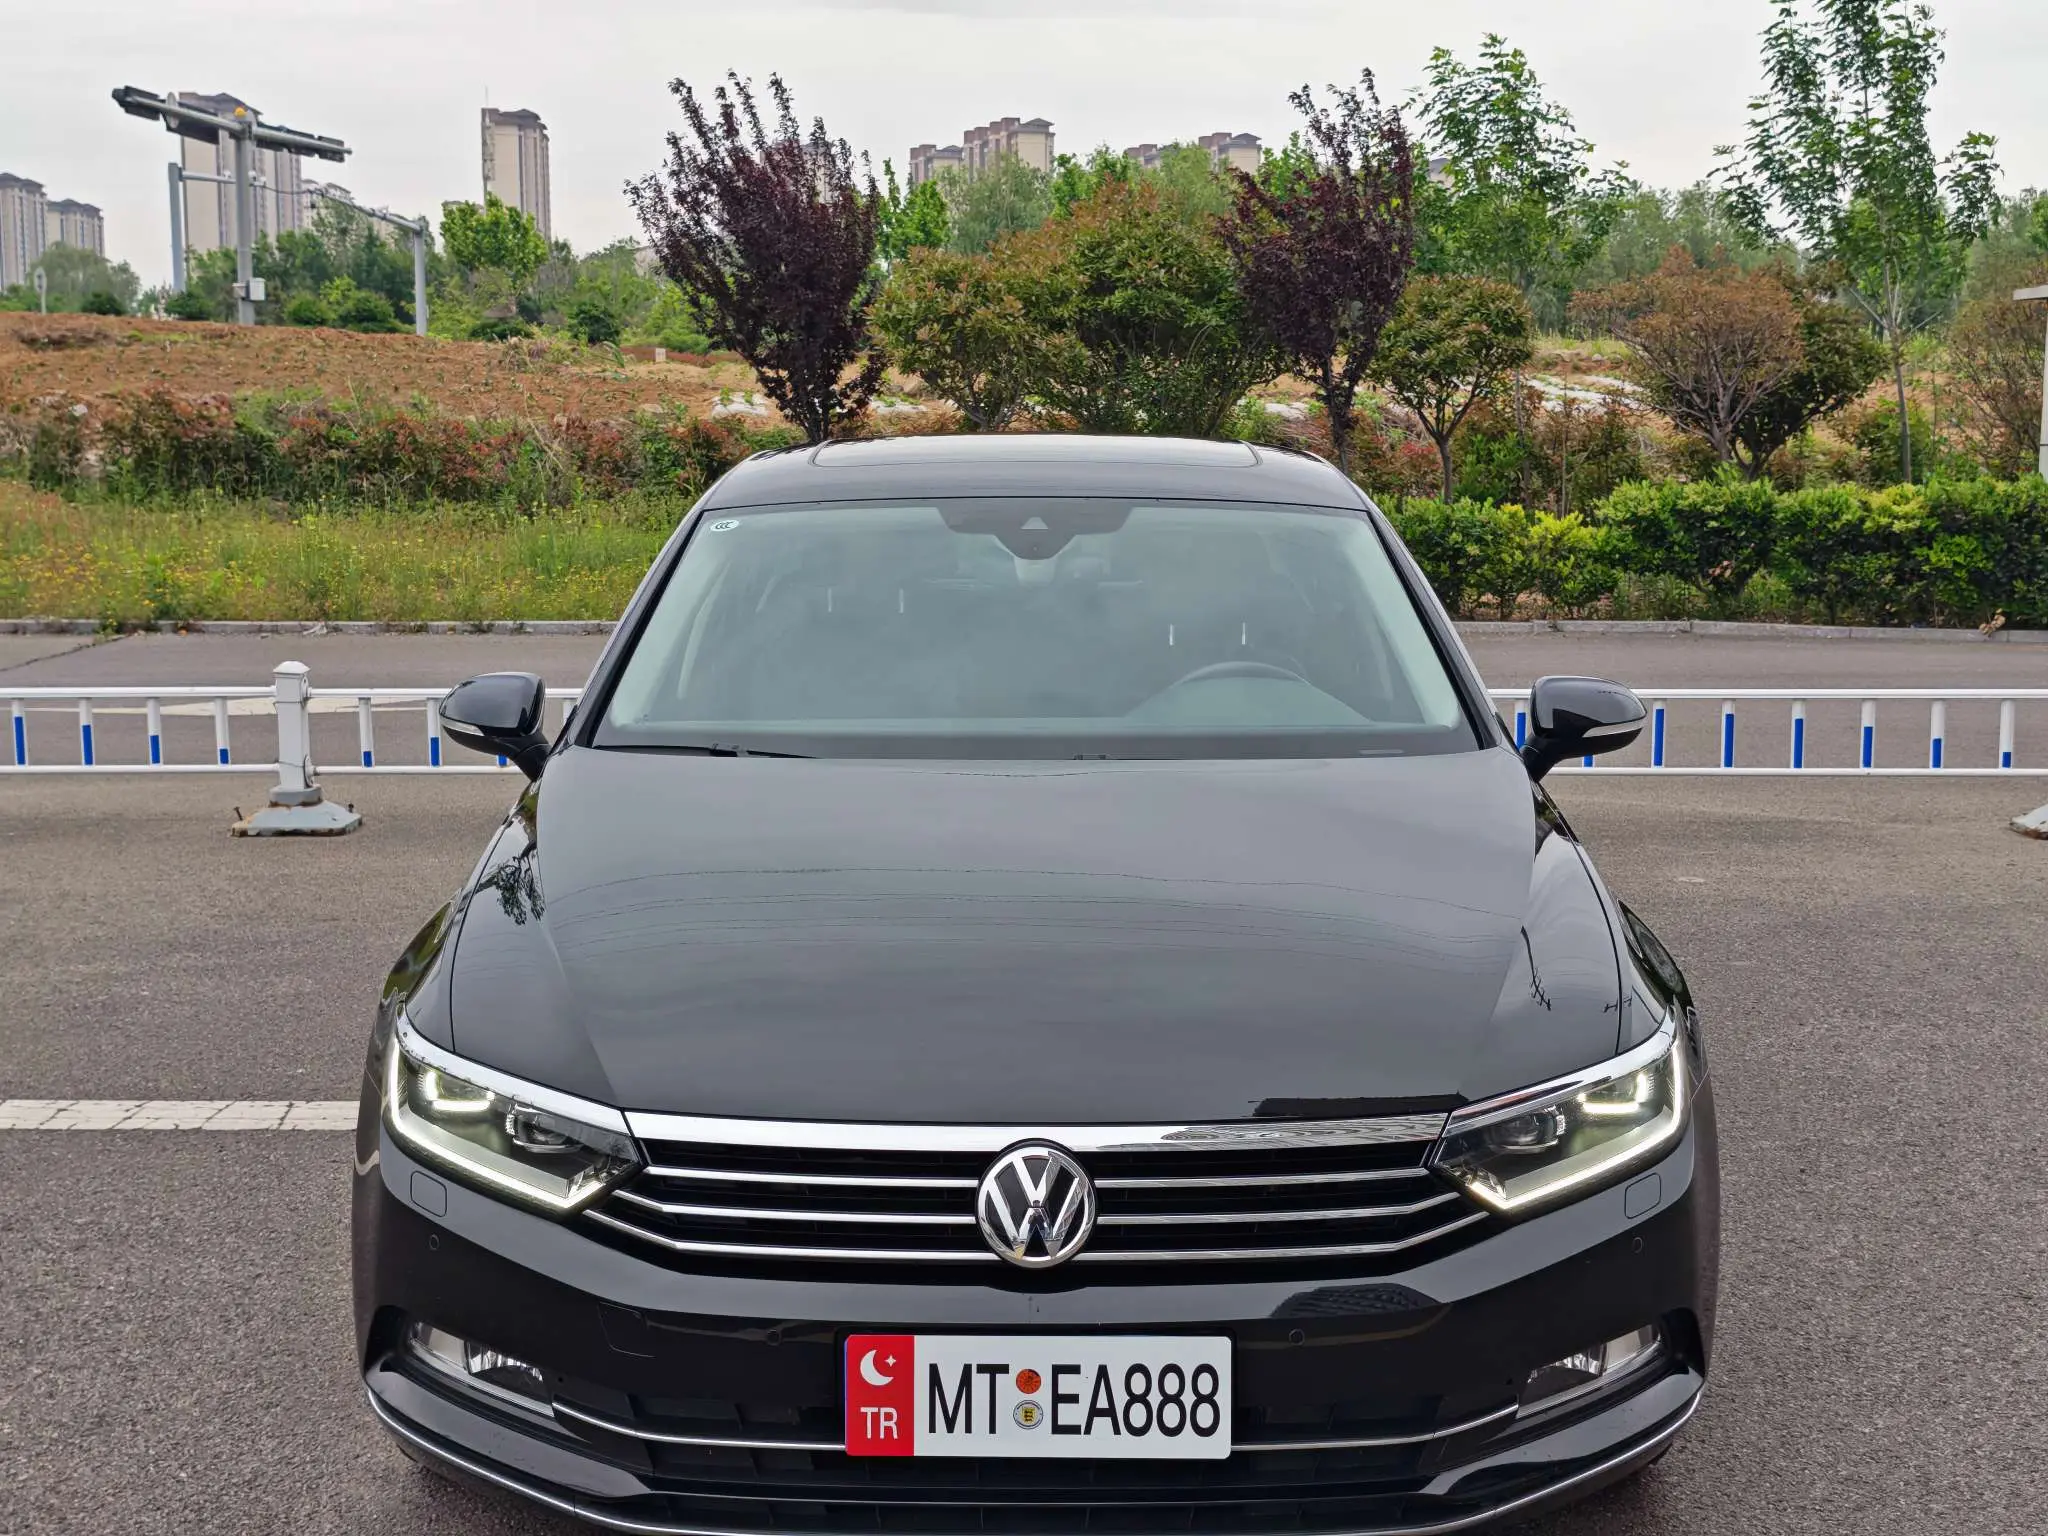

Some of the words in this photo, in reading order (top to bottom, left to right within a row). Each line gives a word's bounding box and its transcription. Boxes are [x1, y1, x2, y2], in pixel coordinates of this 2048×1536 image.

[860, 1406, 899, 1440] TR
[928, 1363, 1010, 1435] MT
[1051, 1363, 1221, 1437] EA888
